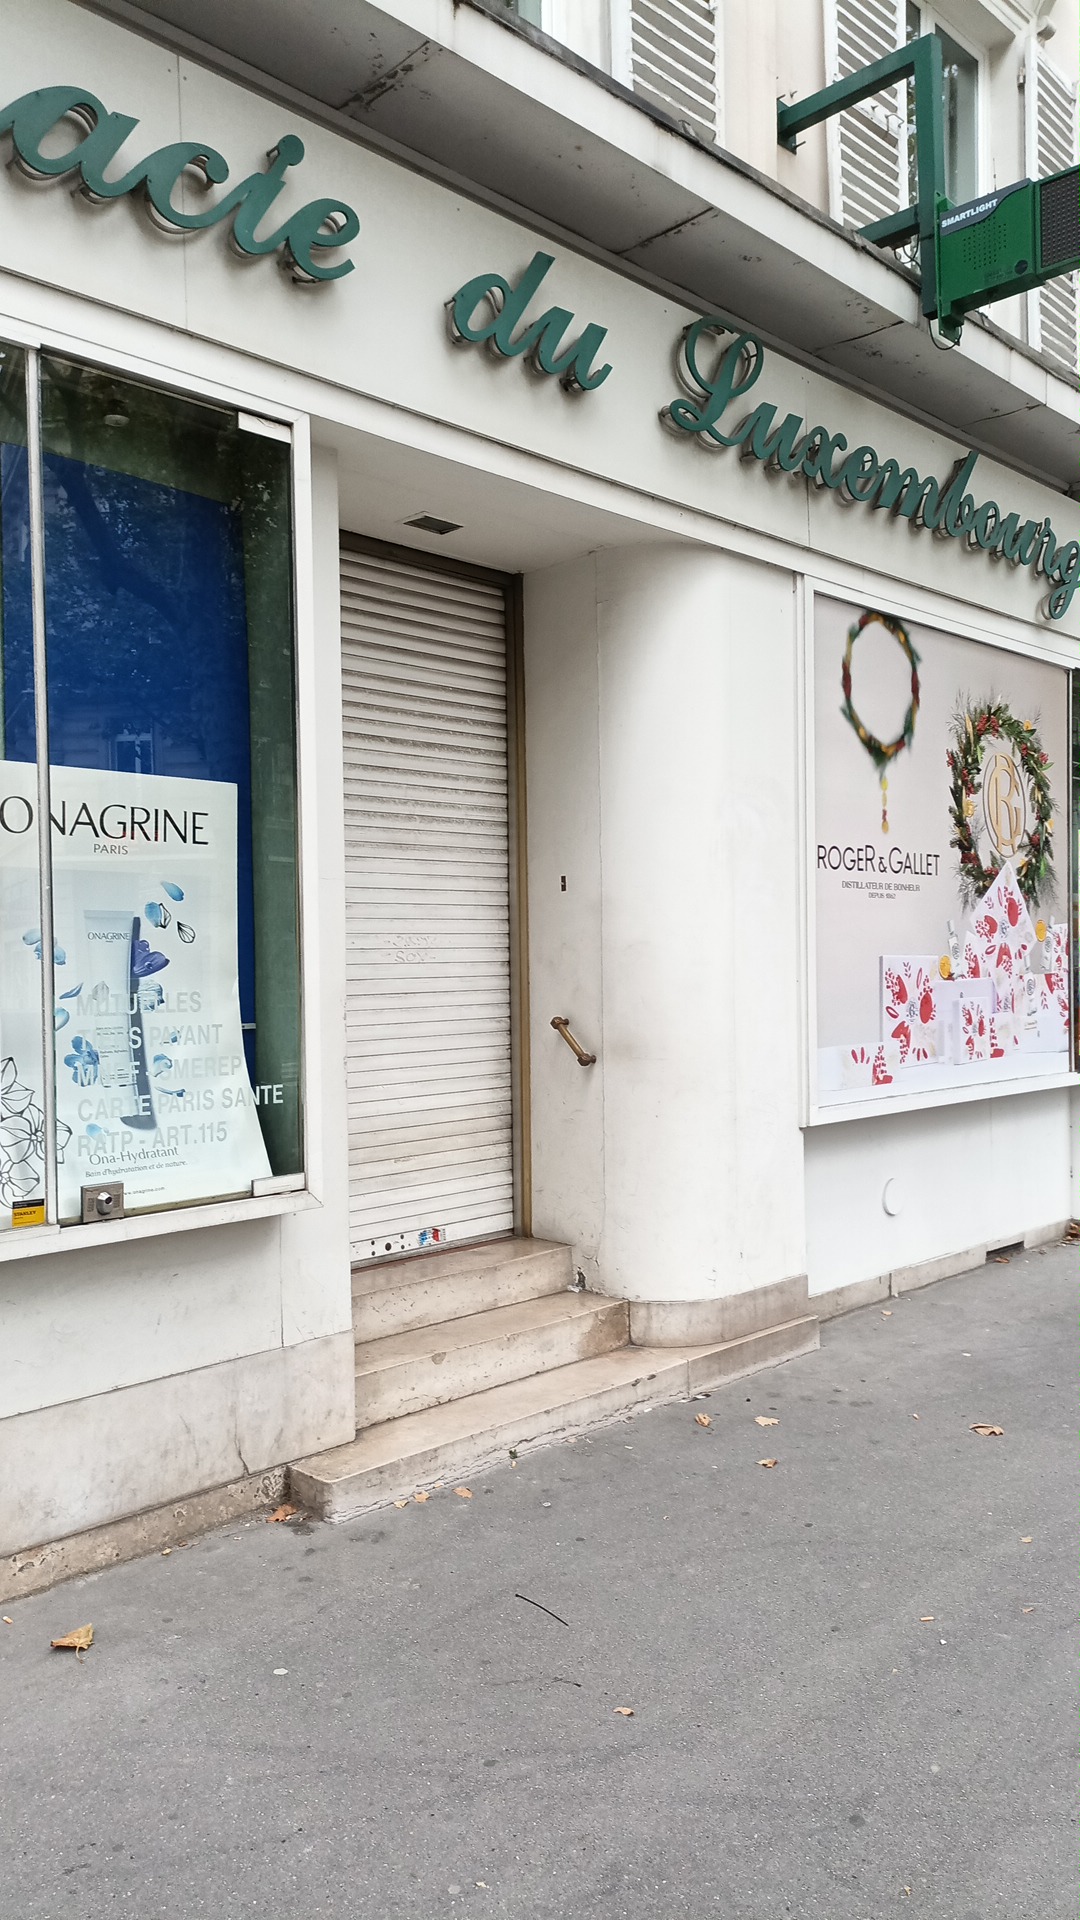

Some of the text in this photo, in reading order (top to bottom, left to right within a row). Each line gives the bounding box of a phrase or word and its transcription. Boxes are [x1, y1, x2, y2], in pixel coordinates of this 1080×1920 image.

[941, 198, 998, 228] SMARTLIGHT
[452, 250, 614, 391] du
[668, 316, 1080, 620] Luxembourg
[0, 795, 209, 846] ONAGRINE
[93, 843, 129, 855] PARIS
[817, 844, 941, 876] ROGER & GALLET
[841, 880, 884, 891] DISTILLATEUR
[884, 882, 893, 891] DE
[87, 931, 131, 941] ONAGRINE
[157, 1088, 216, 1114] PARIS
[221, 1084, 285, 1109] SANTE
[77, 1130, 134, 1157] RATP
[152, 1121, 228, 1149] ART.115
[88, 1146, 180, 1166] Ona-Hydratant
